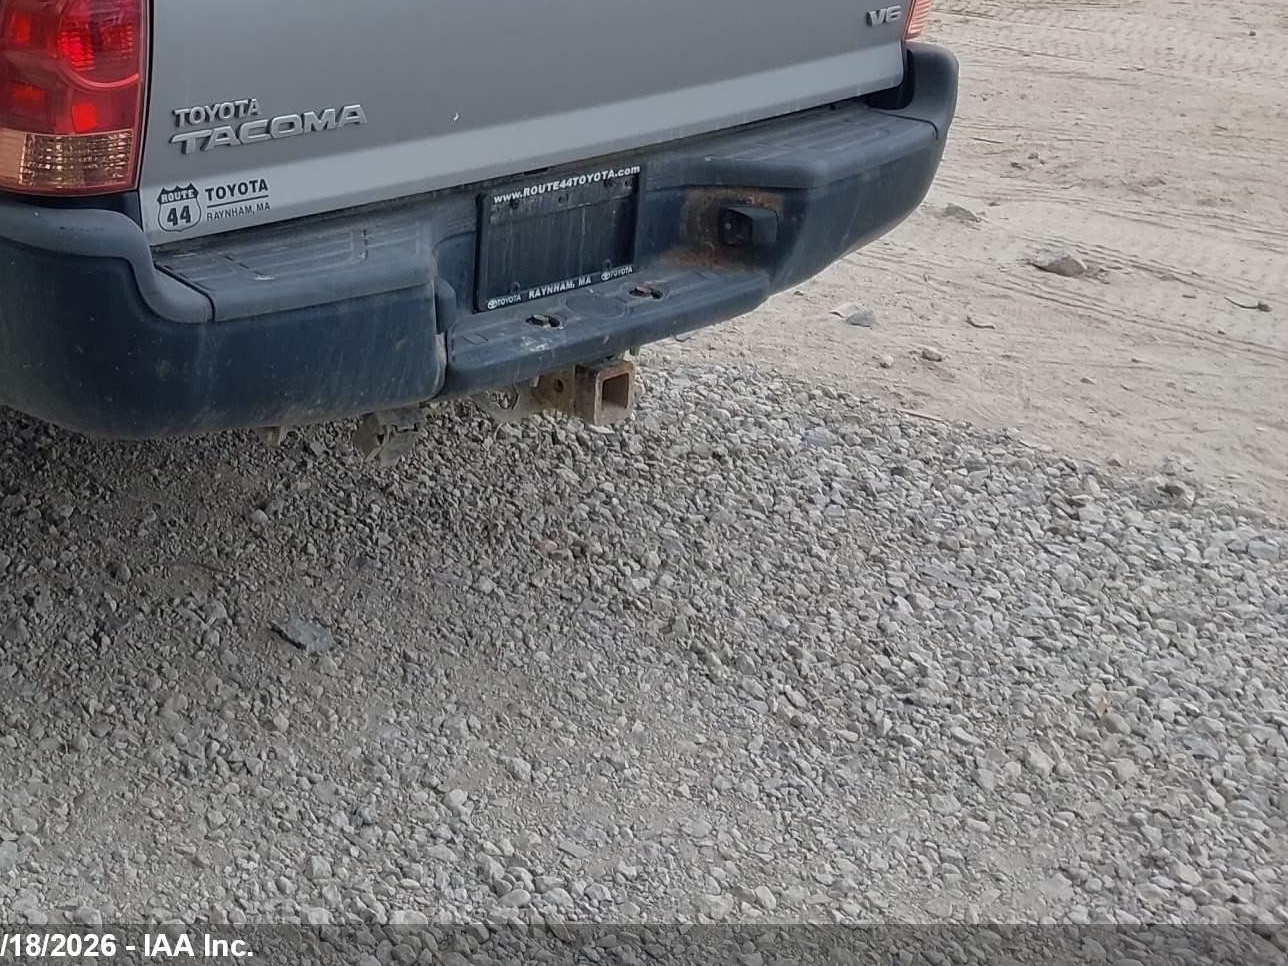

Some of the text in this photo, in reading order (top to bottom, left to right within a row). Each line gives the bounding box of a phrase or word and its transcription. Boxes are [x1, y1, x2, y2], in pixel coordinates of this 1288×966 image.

[865, 4, 902, 26] V6
[172, 98, 262, 128] TOYOTA
[169, 104, 368, 155] TACOMA
[161, 188, 196, 203] ROUTE
[205, 178, 269, 202] TOYOTA
[493, 165, 641, 204] www.ROUTE44TOYOTA.com
[166, 204, 192, 227] 44
[207, 201, 271, 222] RAYNHAM, MA
[498, 294, 522, 306] TOYOTA
[578, 276, 592, 287] MA
[609, 266, 633, 278] TOYOTA
